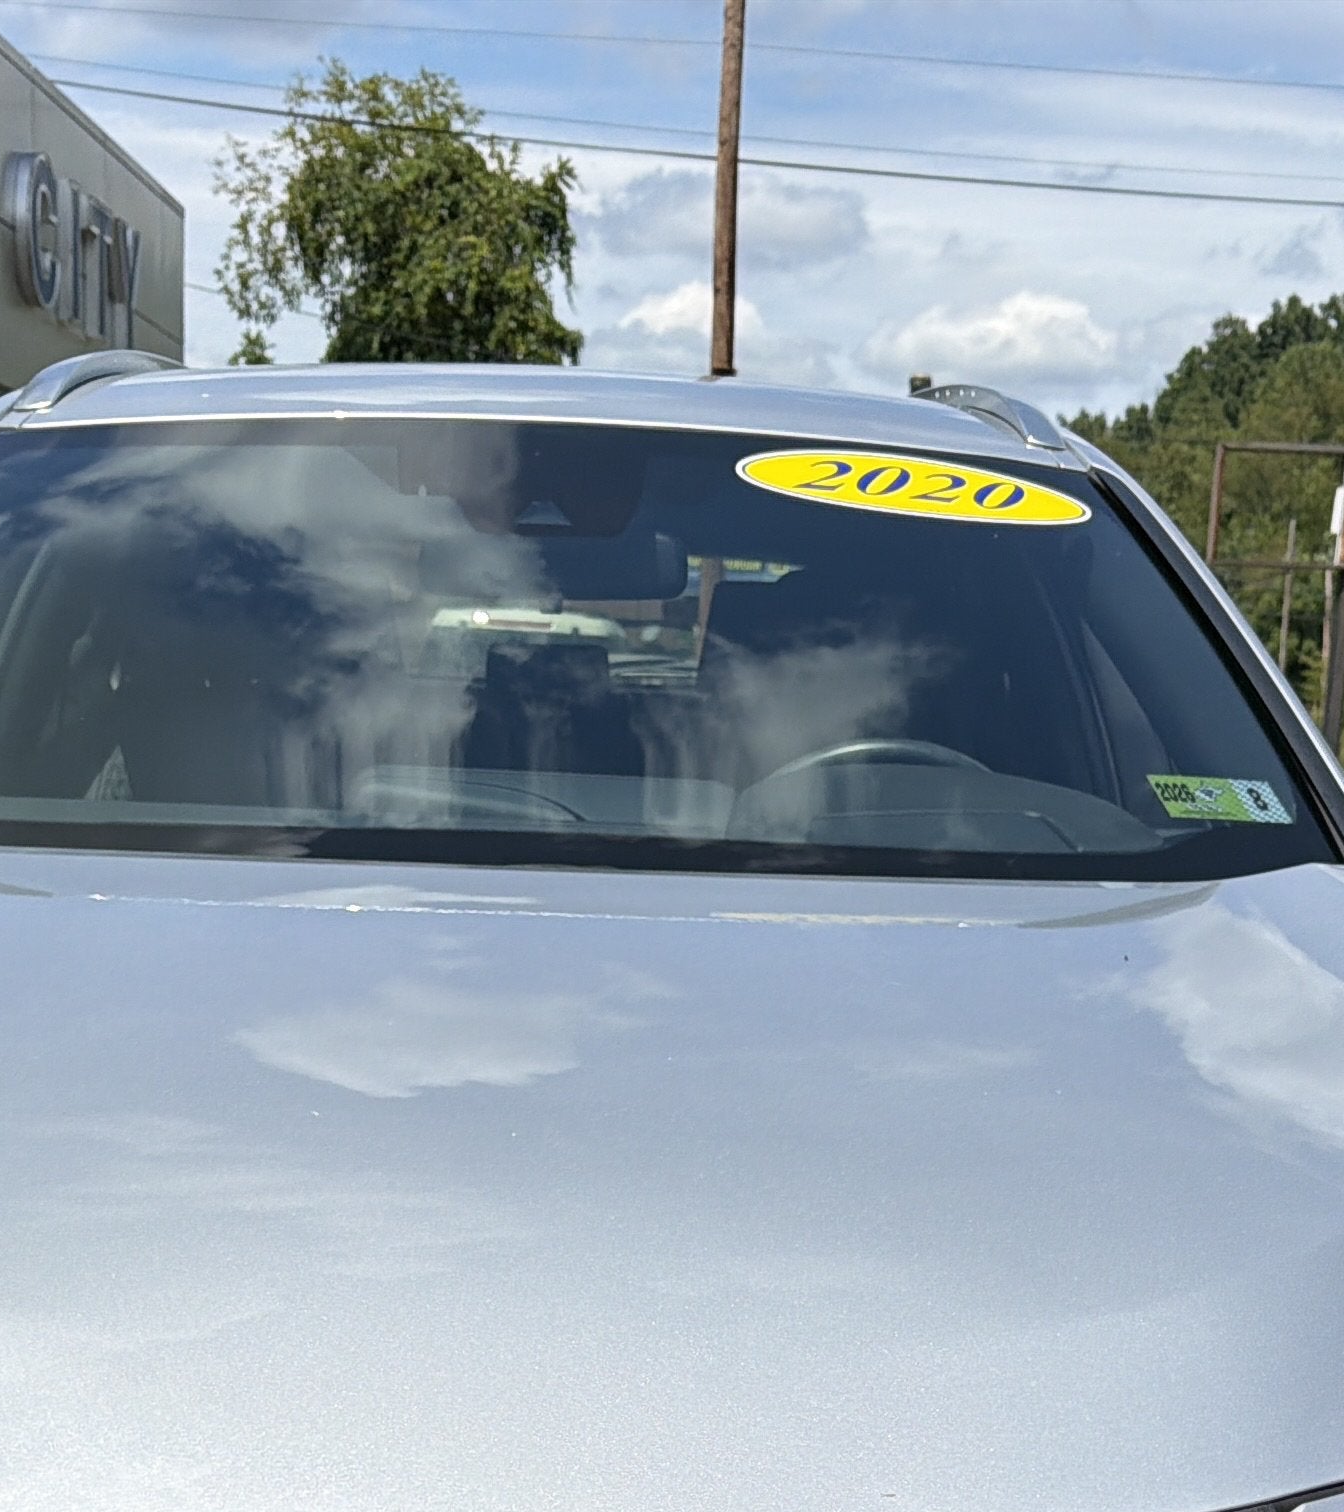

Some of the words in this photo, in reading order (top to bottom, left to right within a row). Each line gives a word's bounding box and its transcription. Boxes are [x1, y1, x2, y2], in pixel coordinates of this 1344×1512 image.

[6, 151, 142, 348] CITY
[791, 460, 1026, 510] 2020
[1155, 782, 1196, 804] 2026
[1246, 787, 1269, 811] 8
